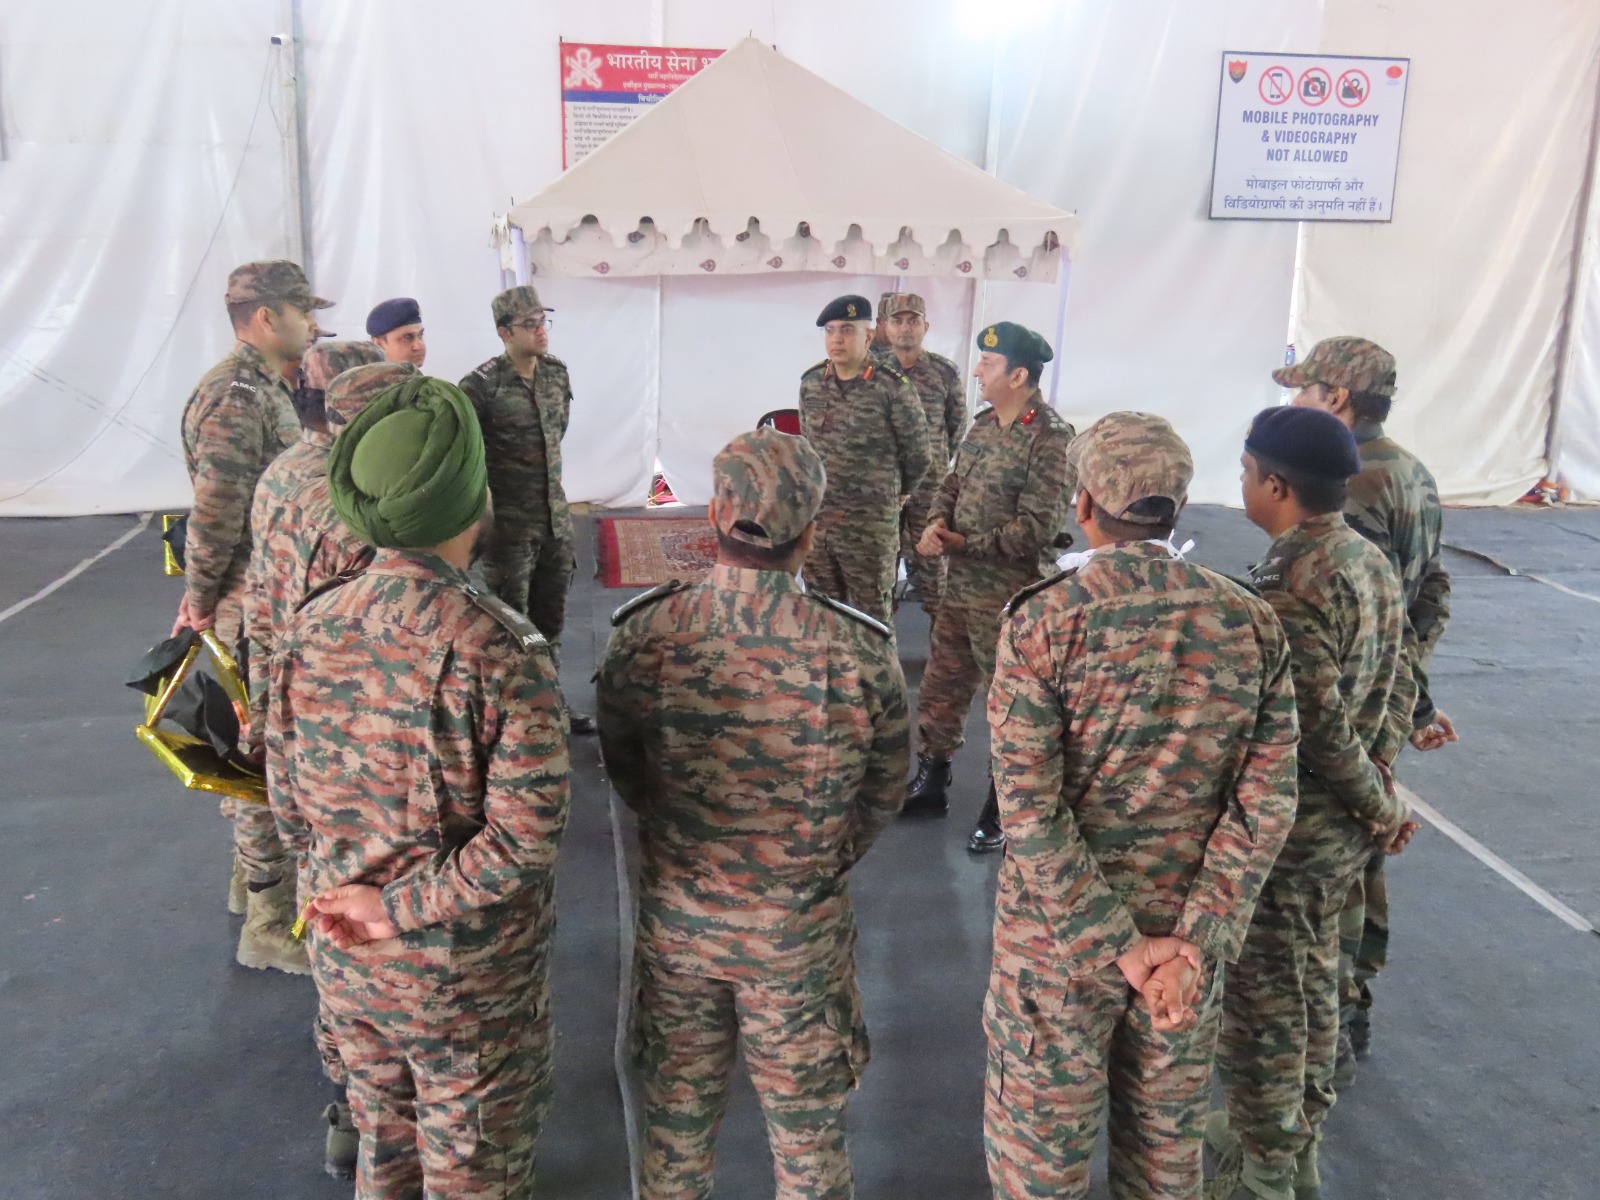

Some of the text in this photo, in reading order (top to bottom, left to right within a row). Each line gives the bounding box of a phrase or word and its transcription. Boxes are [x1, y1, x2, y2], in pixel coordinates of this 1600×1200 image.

[606, 49, 662, 70] भारतीय
[665, 51, 697, 71] सेना
[1242, 110, 1379, 127] MOBILE PHOTOGRAPHY
[1261, 130, 1357, 145] & VIDEOGRAPHY
[1266, 148, 1348, 163] NOT ALLOWED
[1245, 175, 1364, 191] मोबाइल फोटोग्राफी और
[1289, 195, 1304, 210] की
[1307, 197, 1344, 215] अनुमति
[1347, 197, 1367, 212] नहीं
[231, 380, 256, 393] AMC
[1254, 574, 1280, 584] AMC
